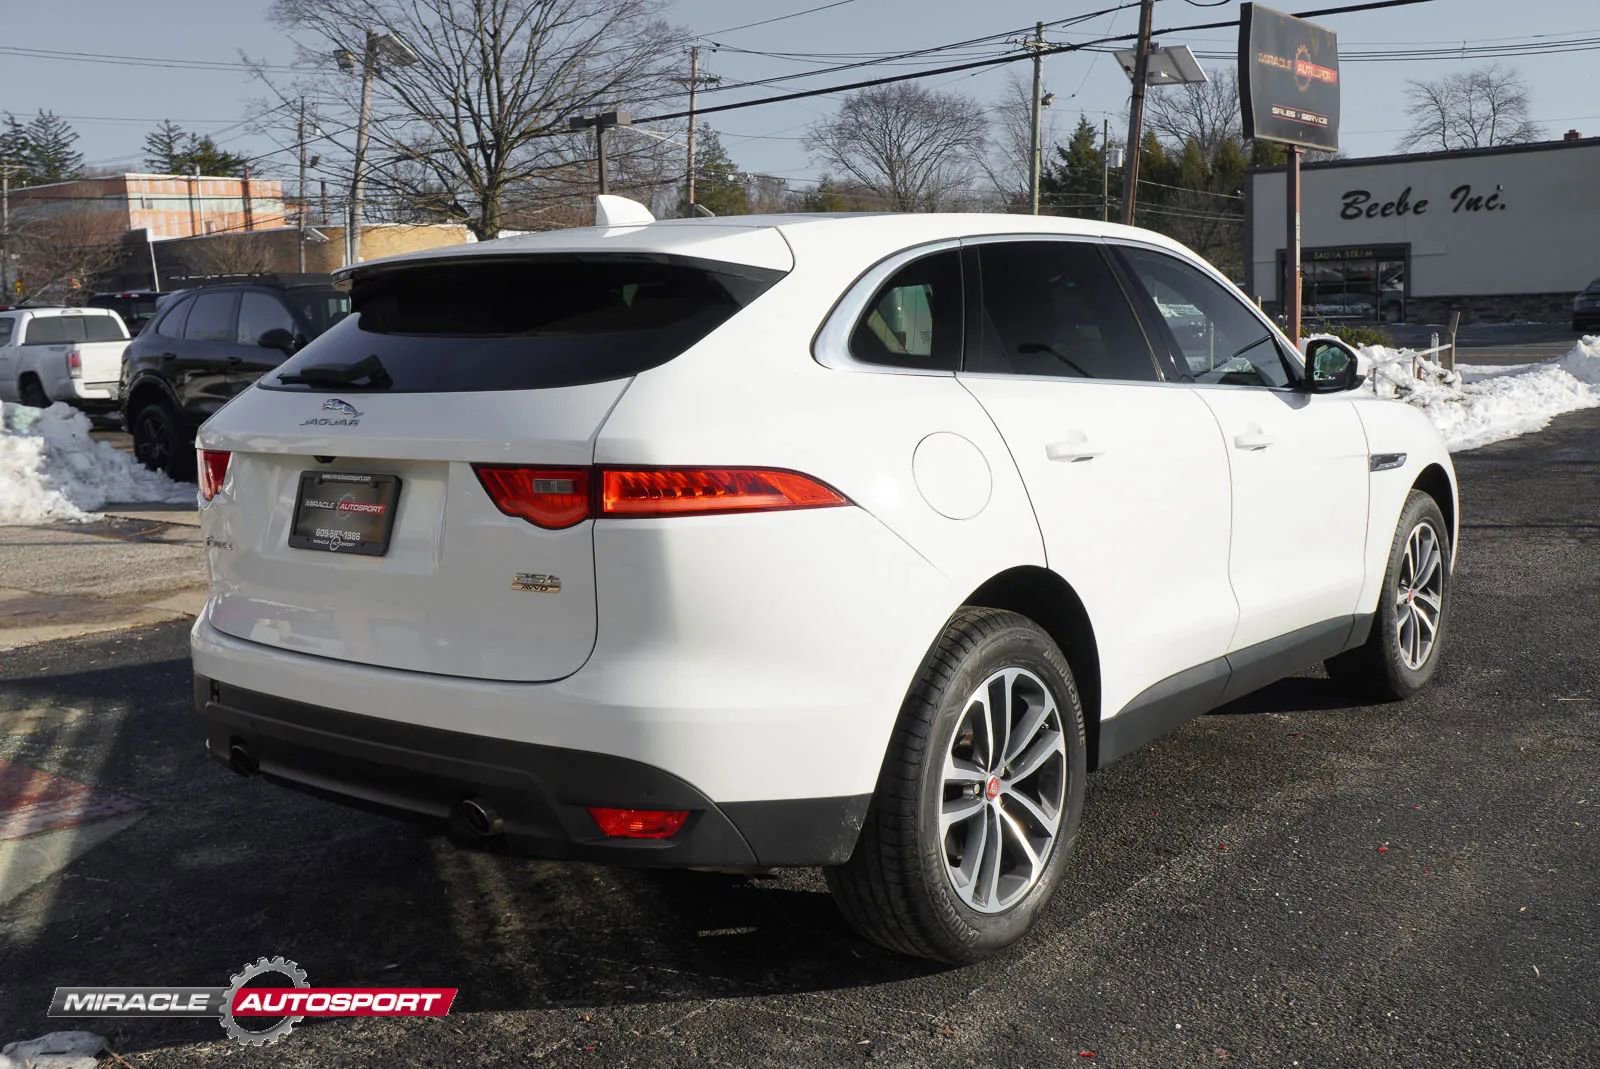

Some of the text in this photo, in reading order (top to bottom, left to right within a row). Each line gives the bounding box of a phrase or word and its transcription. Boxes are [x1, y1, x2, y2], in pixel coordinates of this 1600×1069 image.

[1272, 107, 1328, 125] SALES SERVICE
[1340, 184, 1506, 220] Beebe Inc.
[299, 418, 360, 426] JAGUAR
[305, 500, 383, 513] MIRACLE AUTOSPORT
[521, 583, 548, 592] AWD
